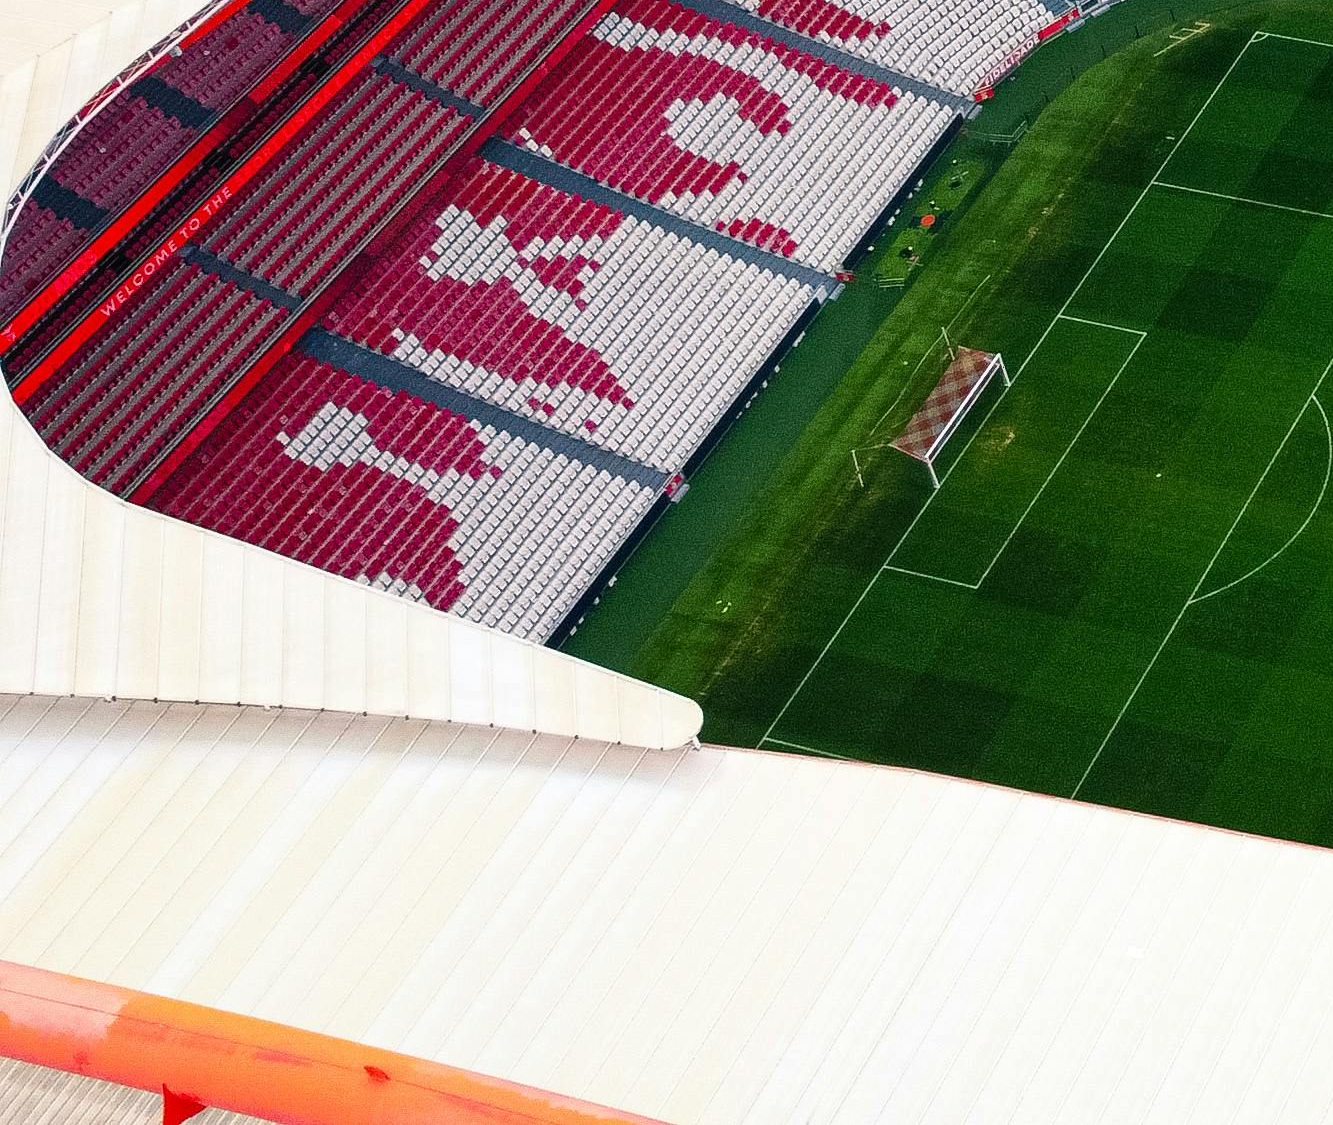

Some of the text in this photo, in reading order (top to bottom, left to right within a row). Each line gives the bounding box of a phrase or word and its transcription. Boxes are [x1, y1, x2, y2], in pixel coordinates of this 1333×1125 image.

[983, 35, 1040, 87] FIDELIDADE
[101, 240, 178, 316] WELCOME
[180, 218, 200, 239] TO
[203, 187, 232, 215] THE
